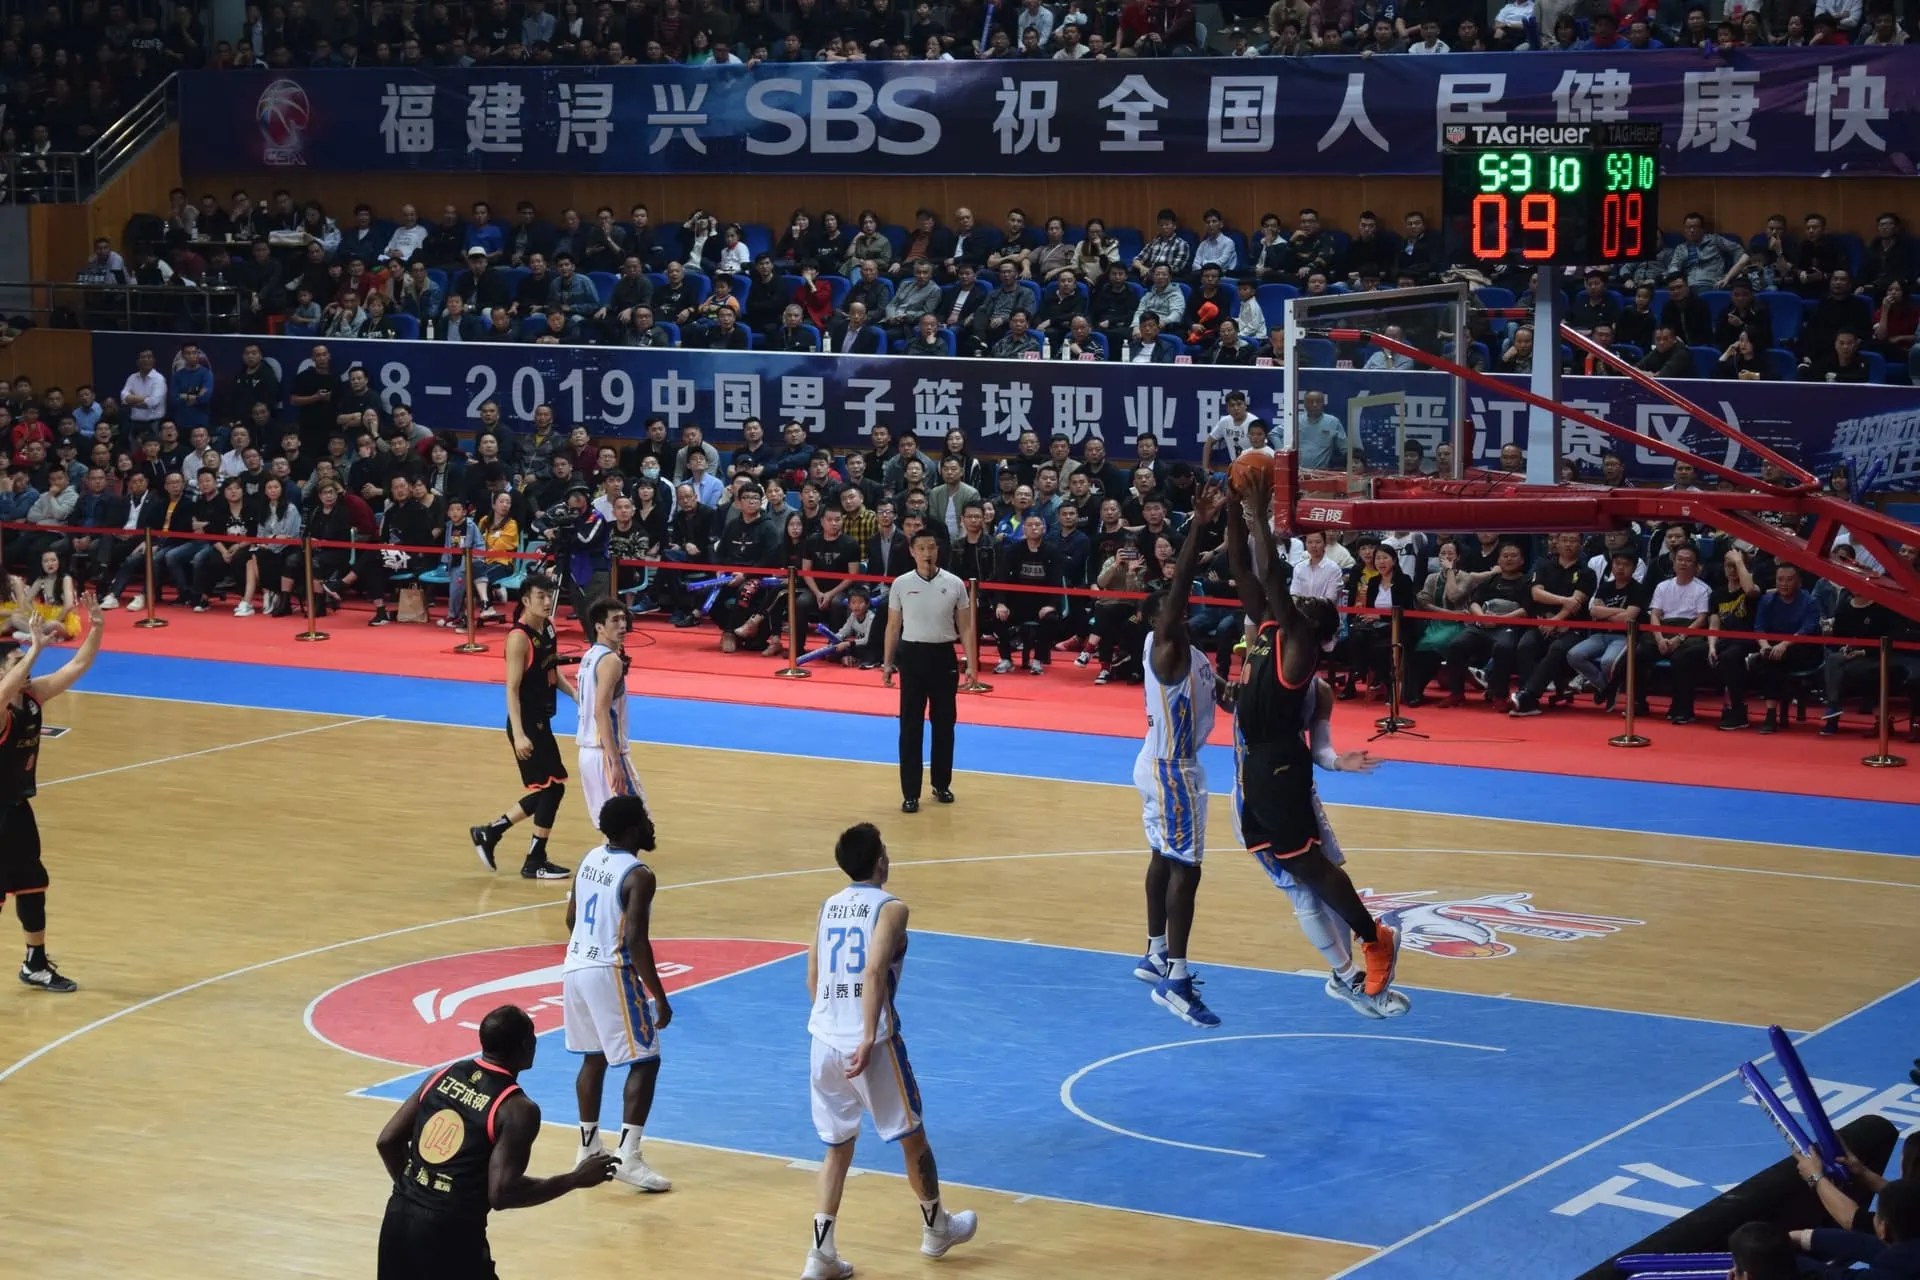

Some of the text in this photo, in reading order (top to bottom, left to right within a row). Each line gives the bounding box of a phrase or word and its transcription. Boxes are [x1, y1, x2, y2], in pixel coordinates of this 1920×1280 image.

[1472, 194, 1556, 258] 09
[1603, 193, 1642, 257] 09
[1310, 507, 1343, 523] 金陵
[584, 892, 599, 937] 4
[827, 926, 866, 975] 73
[437, 1075, 491, 1112] 辽宁本钢
[424, 1116, 460, 1157] 14
